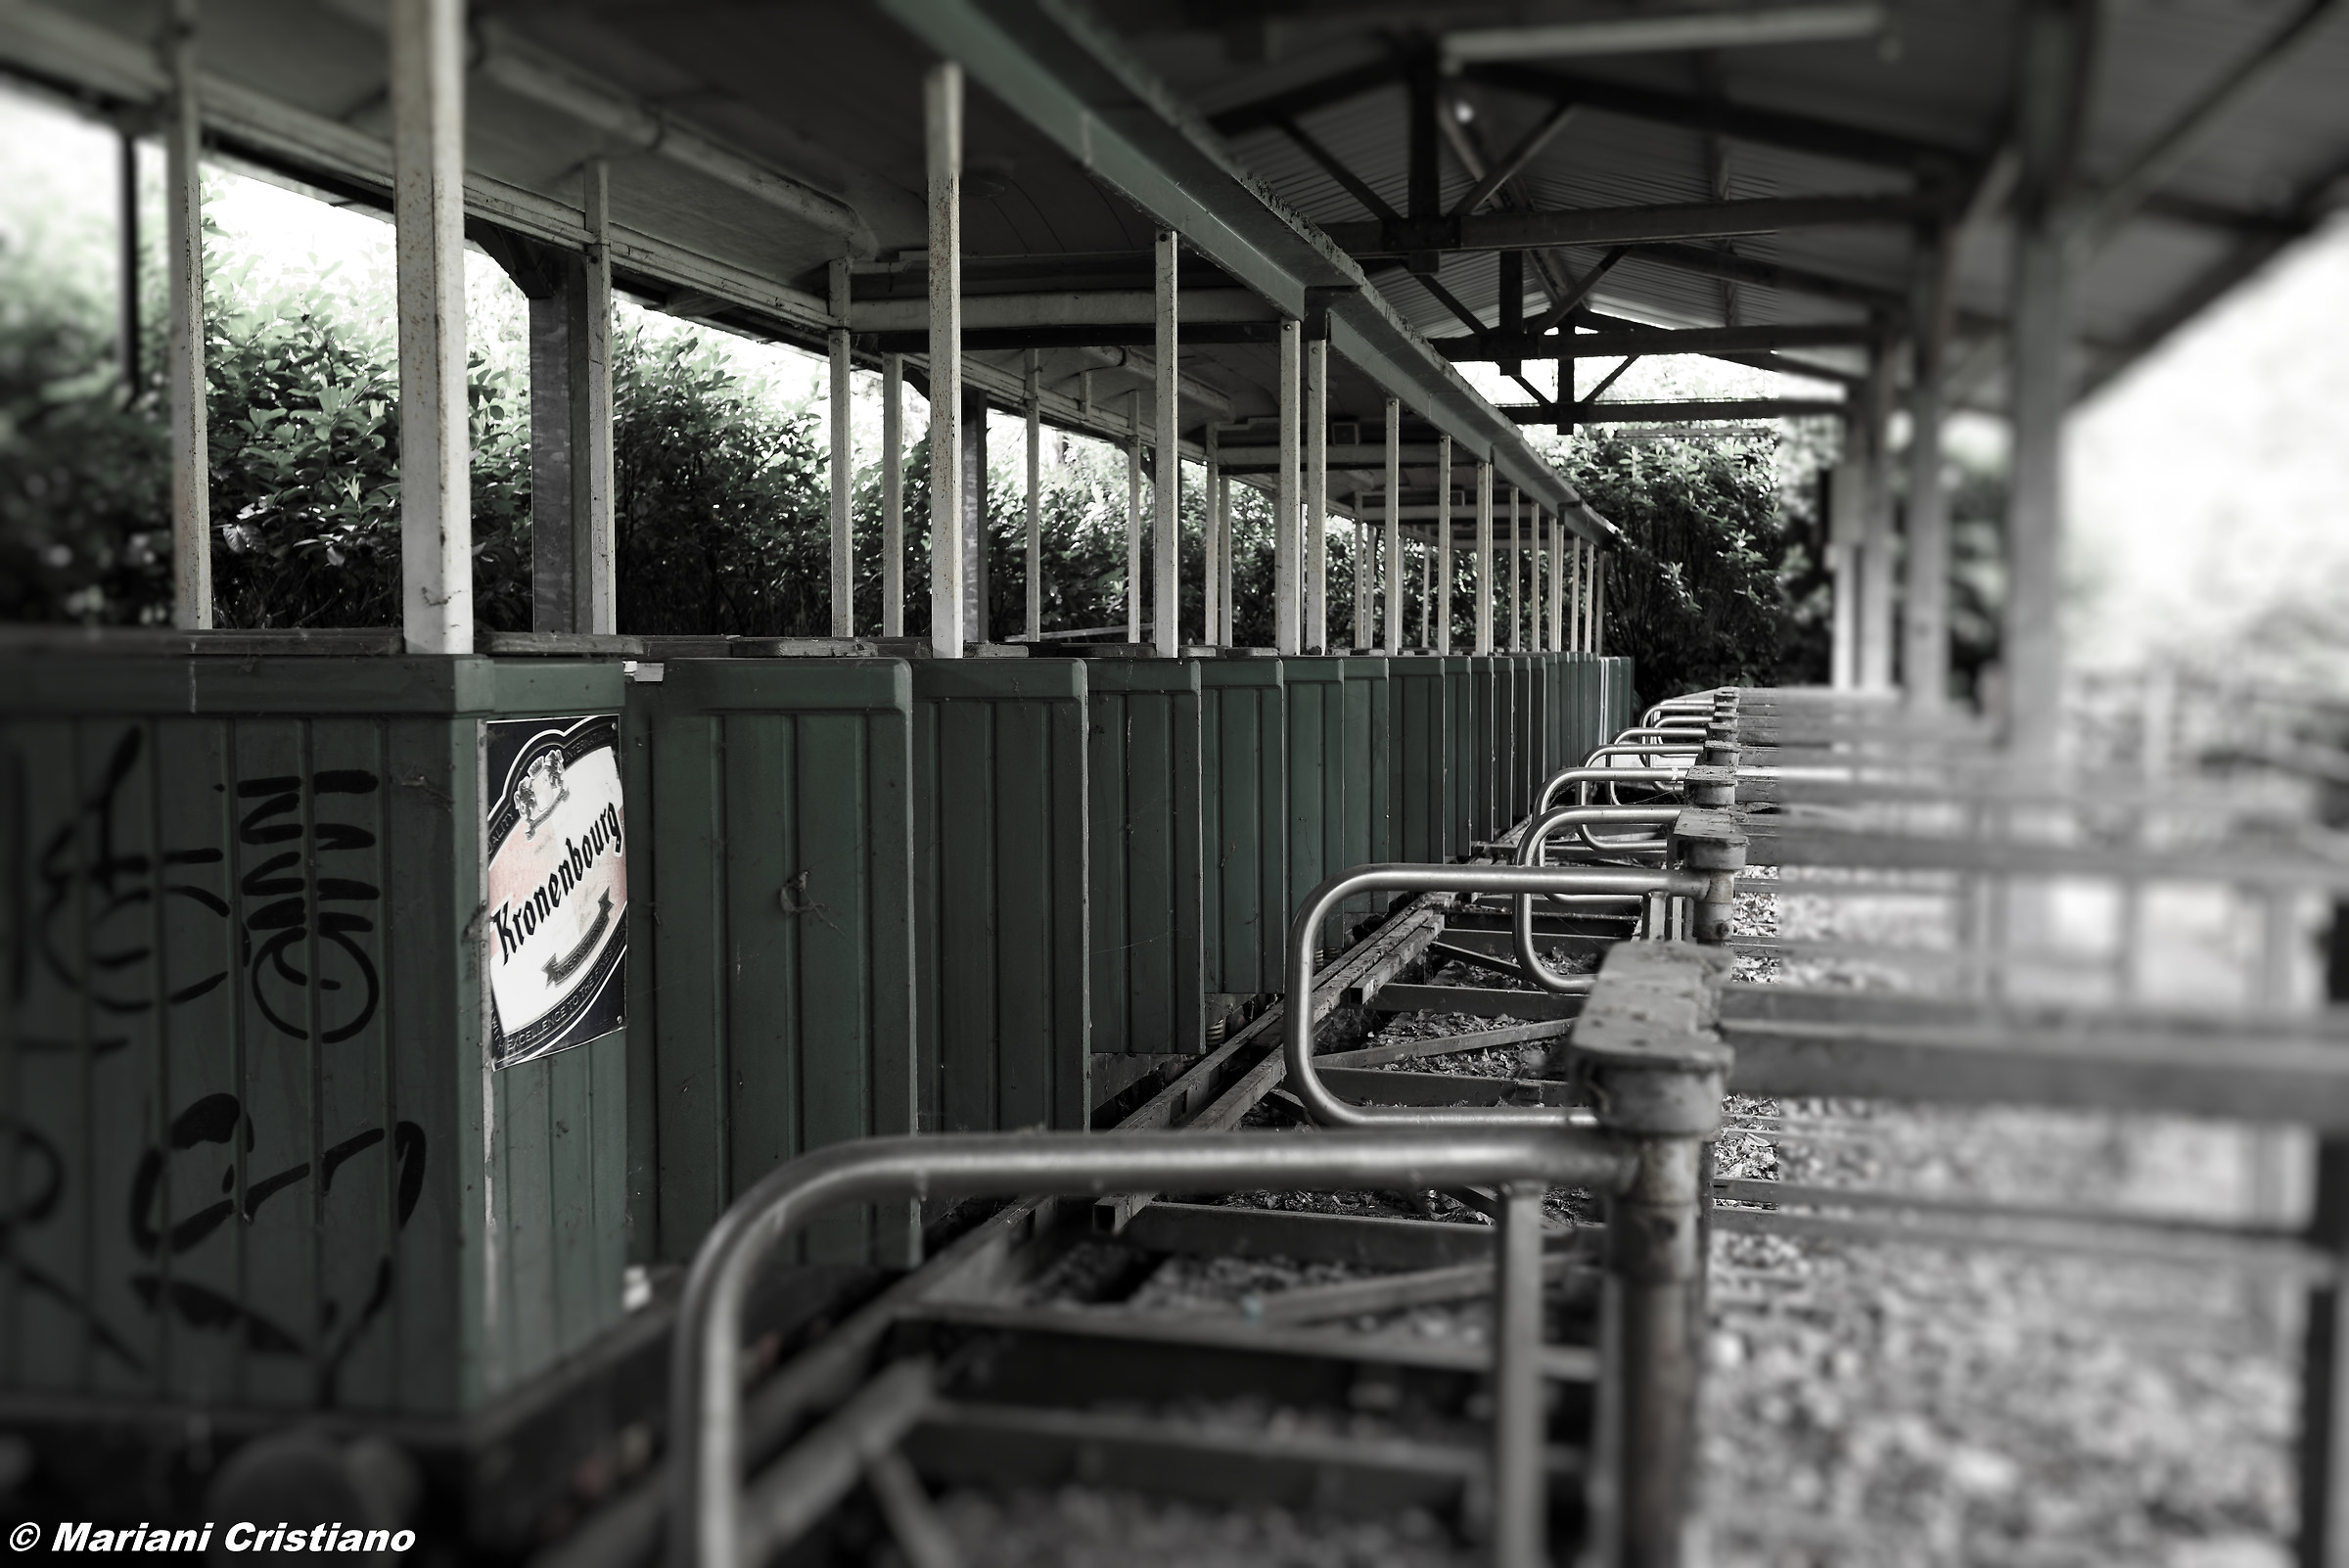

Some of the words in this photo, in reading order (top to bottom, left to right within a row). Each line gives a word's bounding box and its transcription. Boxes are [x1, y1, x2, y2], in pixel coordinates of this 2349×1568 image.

[491, 802, 623, 966] Kronenbourg
[506, 1006, 568, 1052] EXCELLENCE
[566, 994, 579, 1011] TO
[579, 974, 596, 996] THE
